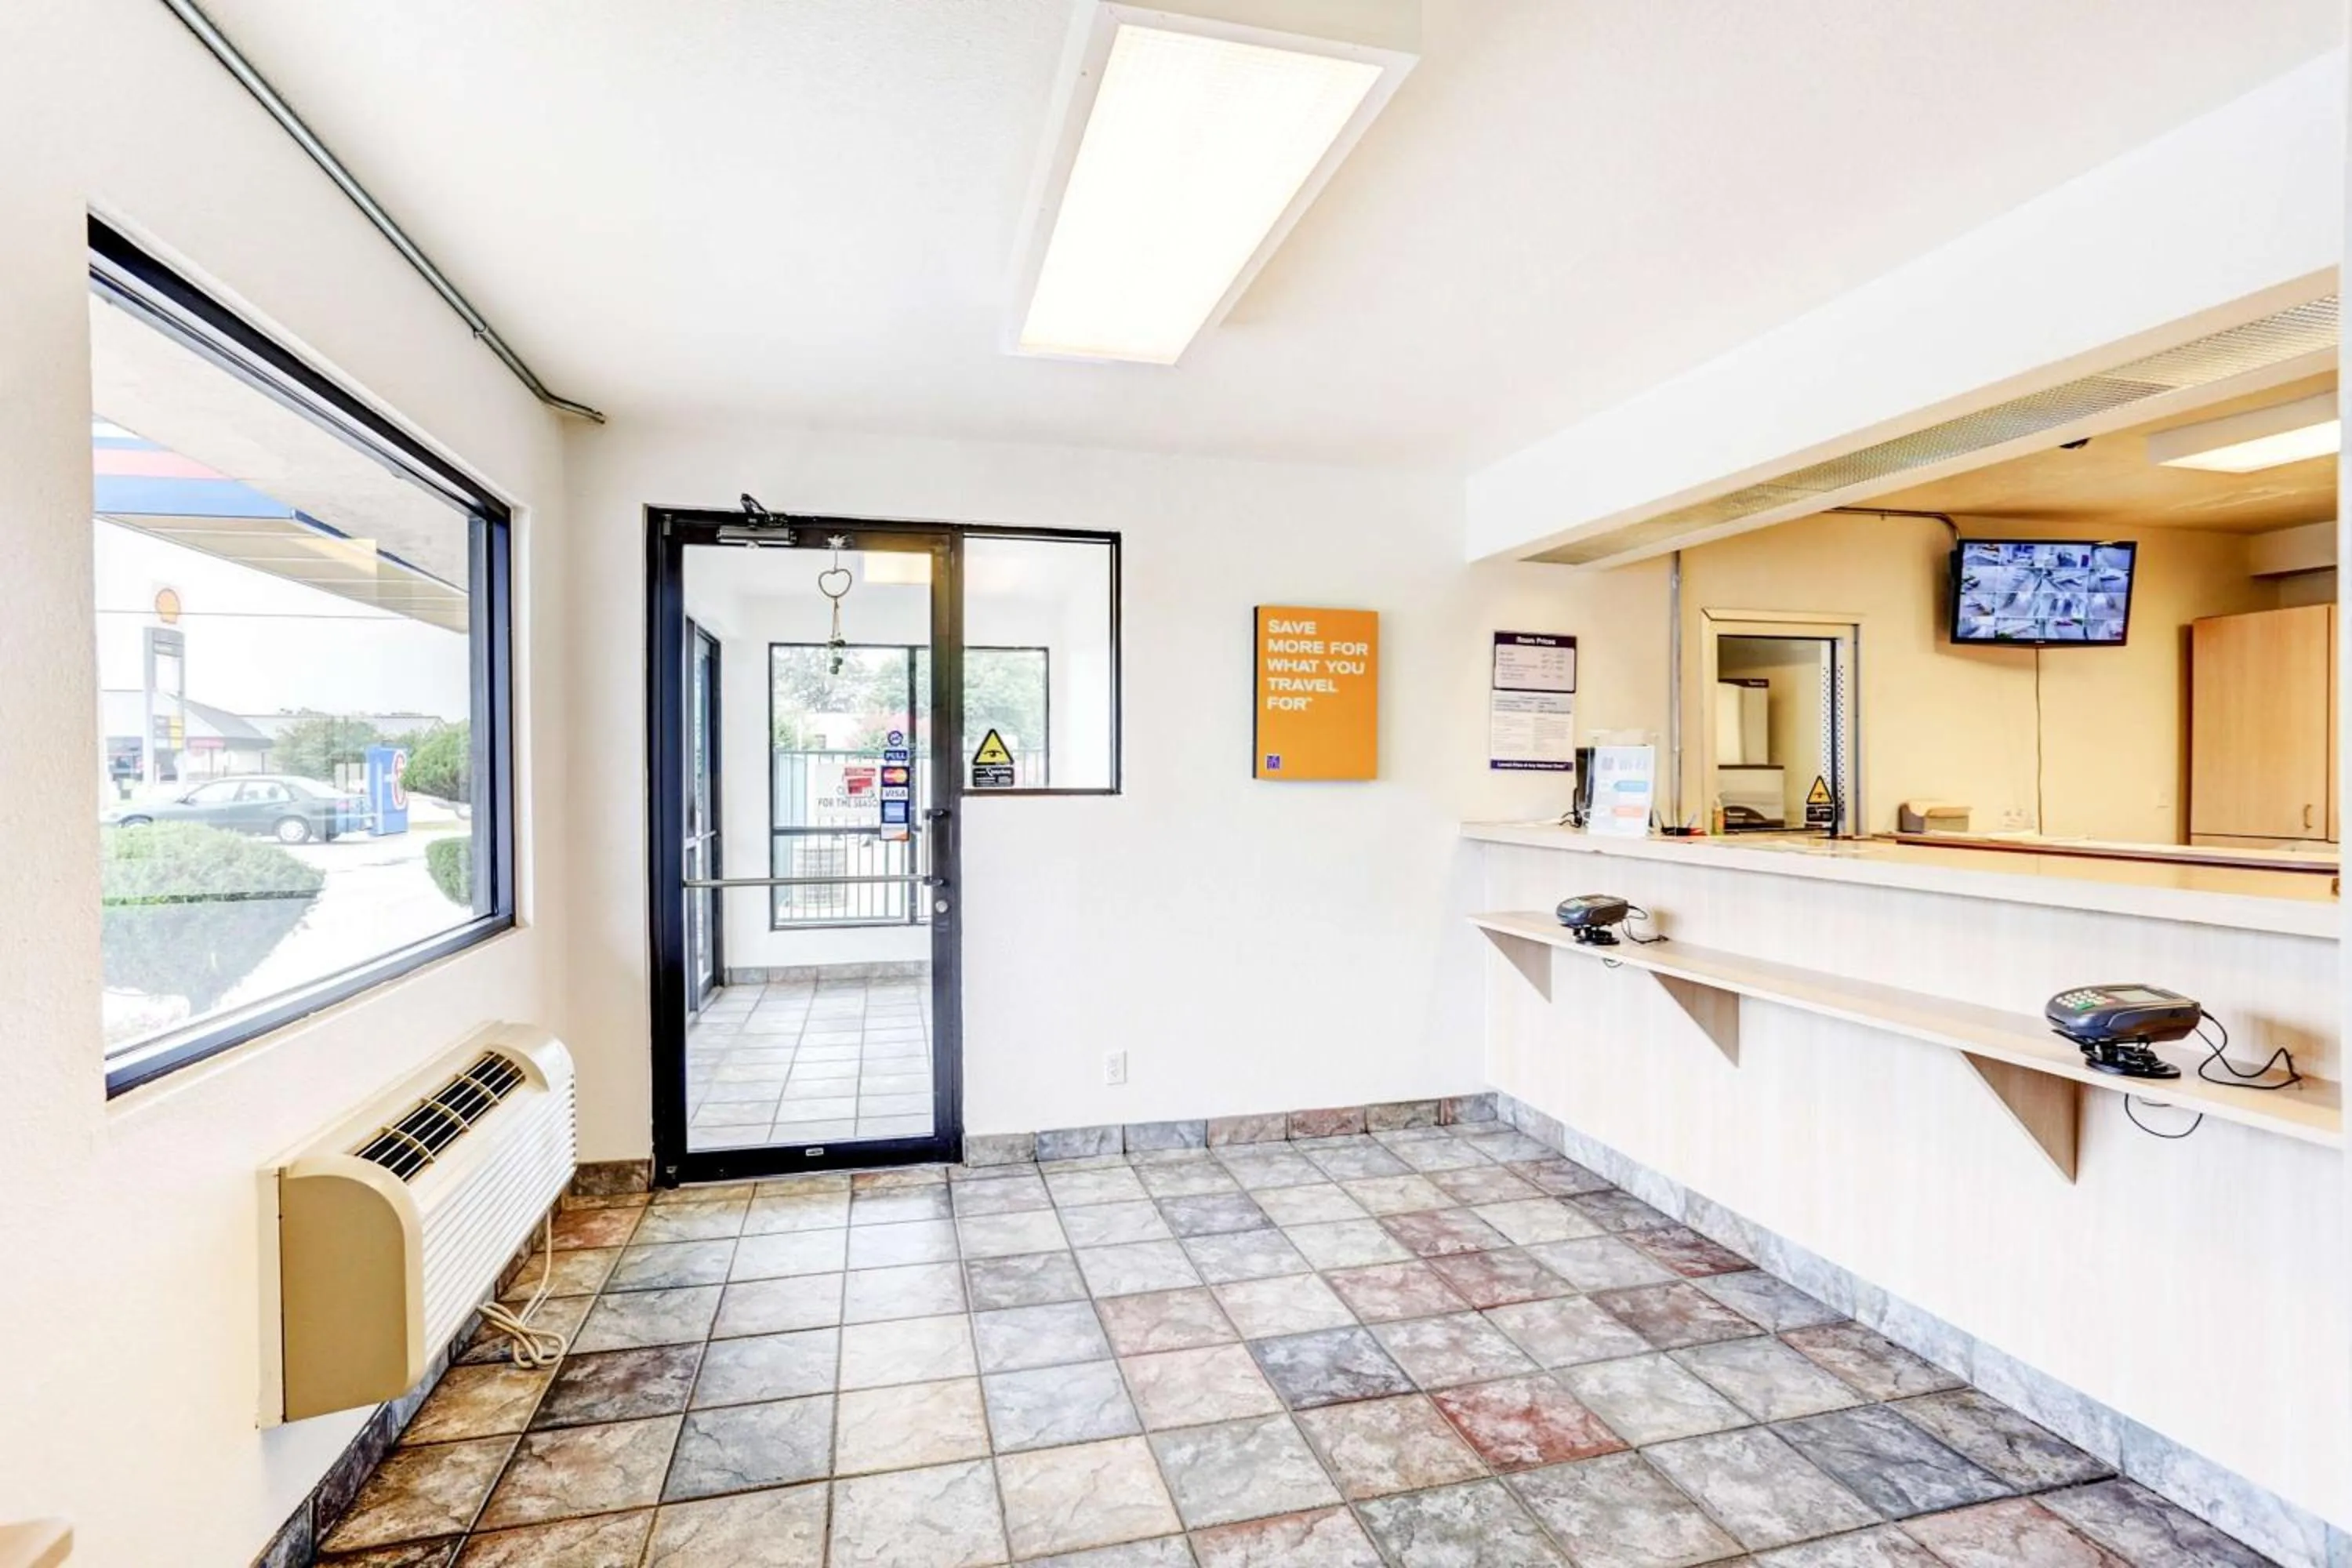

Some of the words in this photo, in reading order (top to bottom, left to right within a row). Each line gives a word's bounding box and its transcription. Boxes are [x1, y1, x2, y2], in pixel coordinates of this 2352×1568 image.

[1268, 619, 1316, 635] SAVE
[1267, 639, 1324, 654] MORE
[1330, 641, 1368, 655] FOR
[1267, 659, 1320, 673] WHAT
[1325, 660, 1365, 675] YOU
[1267, 677, 1339, 693] TRAVEL
[818, 798, 833, 808] FOR
[837, 798, 851, 808] THE
[854, 798, 879, 808] SEASO
